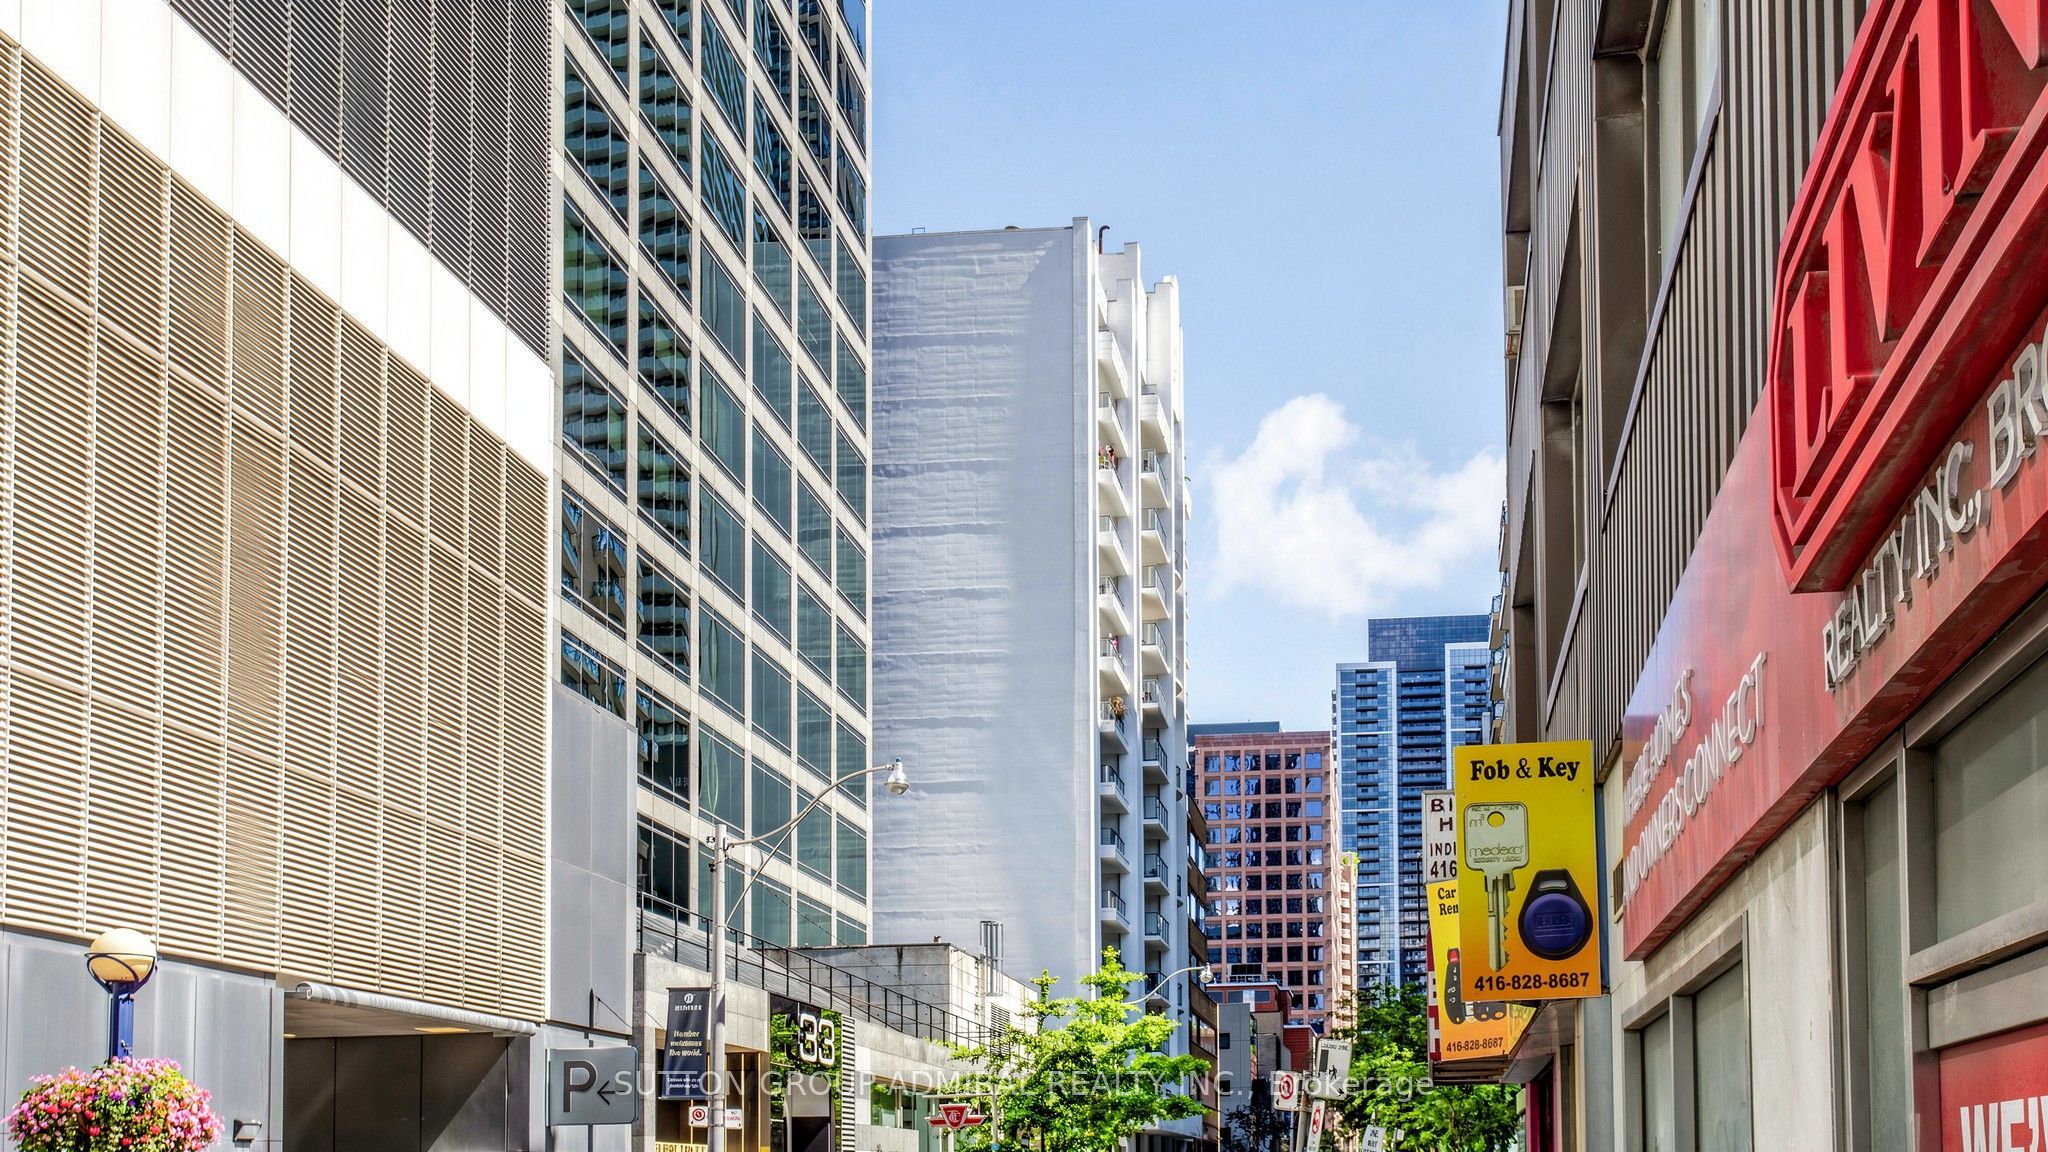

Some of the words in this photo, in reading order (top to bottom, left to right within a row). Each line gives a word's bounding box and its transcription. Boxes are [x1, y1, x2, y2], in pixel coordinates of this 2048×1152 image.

[1822, 515, 1912, 692] REALTY
[1915, 441, 1986, 579] INC.,
[1987, 320, 2048, 490] BR
[1470, 759, 1510, 781] Fob
[1516, 757, 1532, 779] &
[1538, 757, 1580, 781] Key
[1639, 777, 1685, 879] OWNERS
[1683, 651, 1767, 817] CONNECT
[1430, 860, 1458, 878] 416
[1437, 887, 1457, 900] Car
[1474, 972, 1590, 992] 416-828-8687
[798, 1013, 835, 1067] 33
[1446, 1037, 1504, 1053] 416-828-8687
[563, 1061, 597, 1113] P
